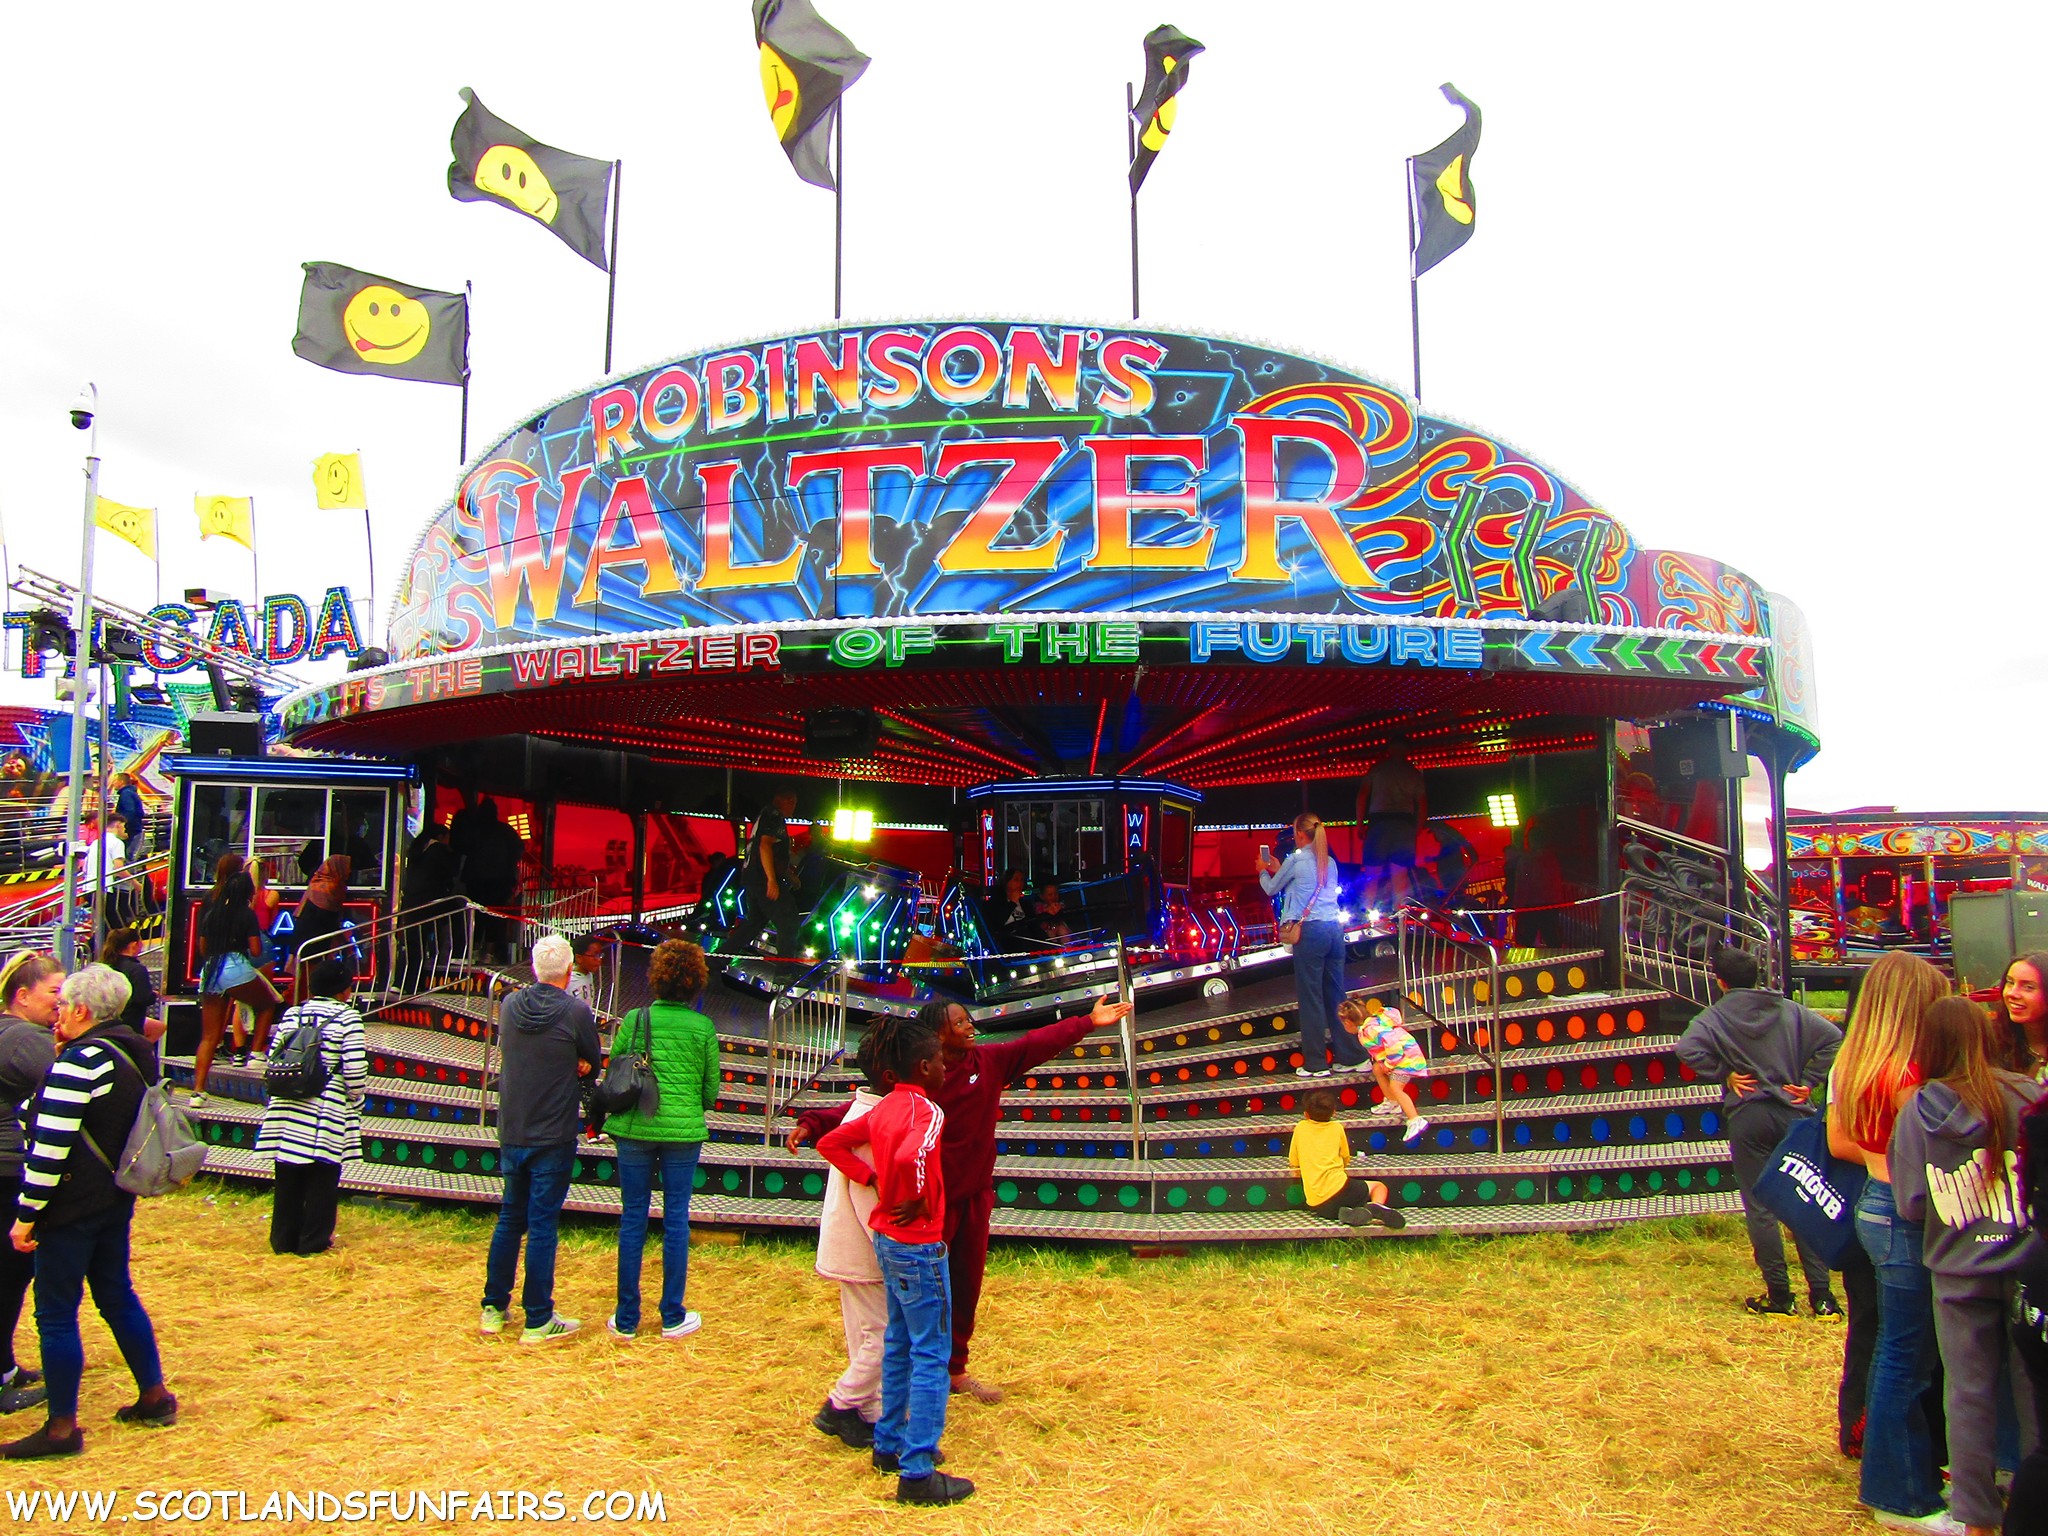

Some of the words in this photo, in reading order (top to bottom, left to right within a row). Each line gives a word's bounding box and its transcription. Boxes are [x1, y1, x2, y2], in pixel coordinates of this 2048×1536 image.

[590, 327, 1168, 469] ROBINSON'S
[479, 414, 1390, 632] WALTZER
[3, 587, 363, 678] TGADA
[340, 676, 386, 716] ITS
[410, 659, 483, 702] THE
[511, 634, 781, 688] WALTZER
[829, 625, 936, 668] OF
[990, 622, 1140, 663] THE
[1190, 623, 1483, 667] FUTURE
[985, 815, 993, 887] WALT
[1128, 813, 1143, 867] WA
[1791, 869, 1829, 878] DISCO
[1975, 1234, 2012, 1243] ARCHI
